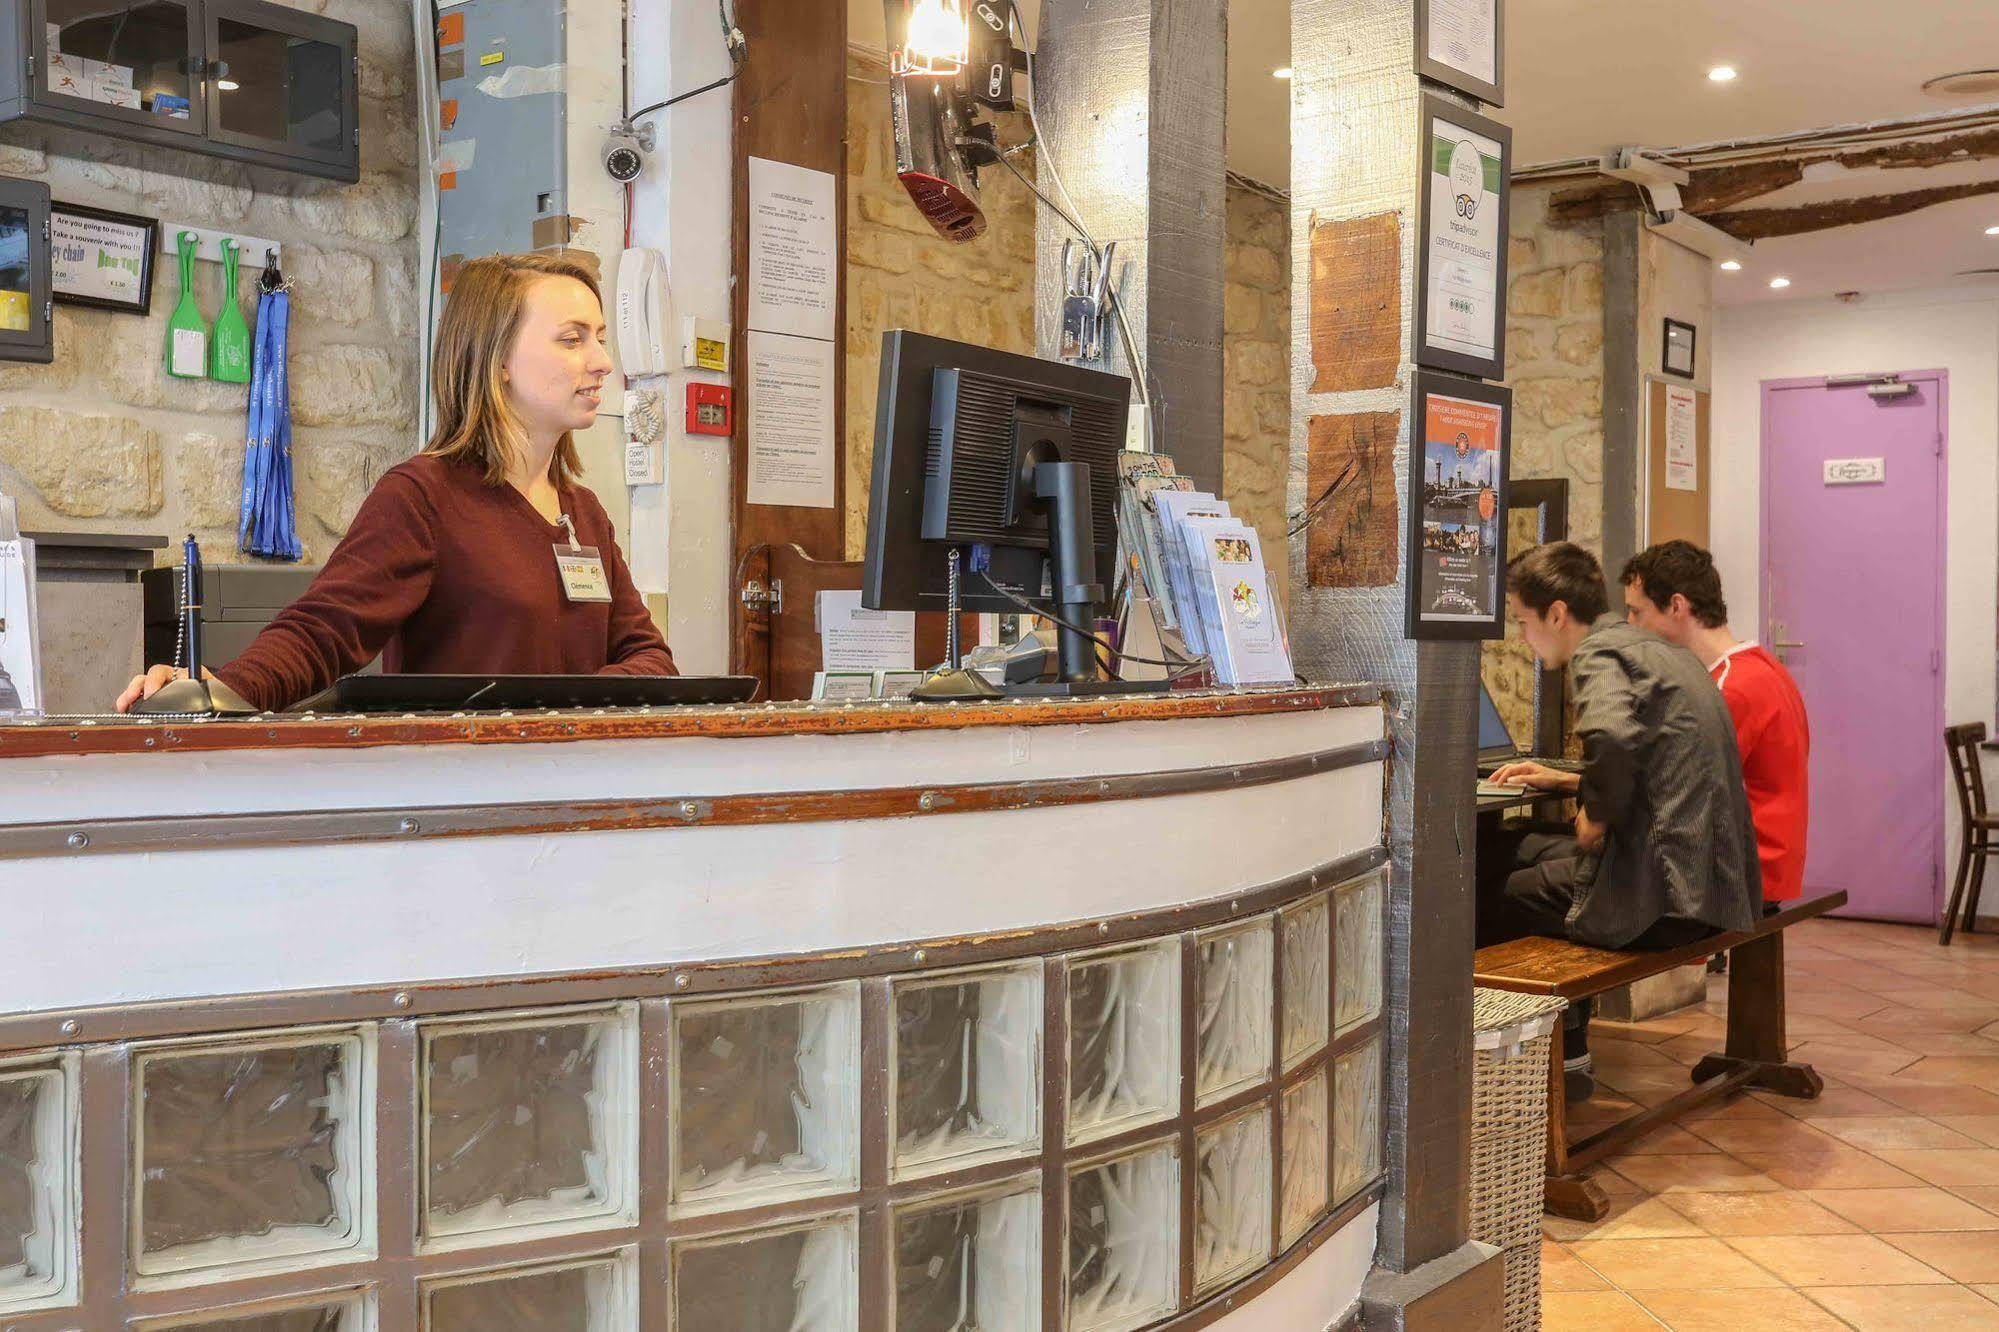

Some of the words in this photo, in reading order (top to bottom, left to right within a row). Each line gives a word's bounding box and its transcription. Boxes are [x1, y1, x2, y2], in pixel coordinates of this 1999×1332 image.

[57, 217, 68, 225] Are
[70, 220, 82, 228] you
[84, 223, 101, 232] going
[111, 227, 125, 236] miss
[1449, 221, 1478, 236] tripadvisor
[52, 230, 68, 239] Take
[75, 235, 103, 245] souvenir
[104, 240, 119, 248] with
[52, 245, 61, 263] ey
[62, 243, 85, 262] chain
[629, 449, 645, 458] Open
[1143, 461, 1156, 470] THE
[629, 469, 649, 478] Closed
